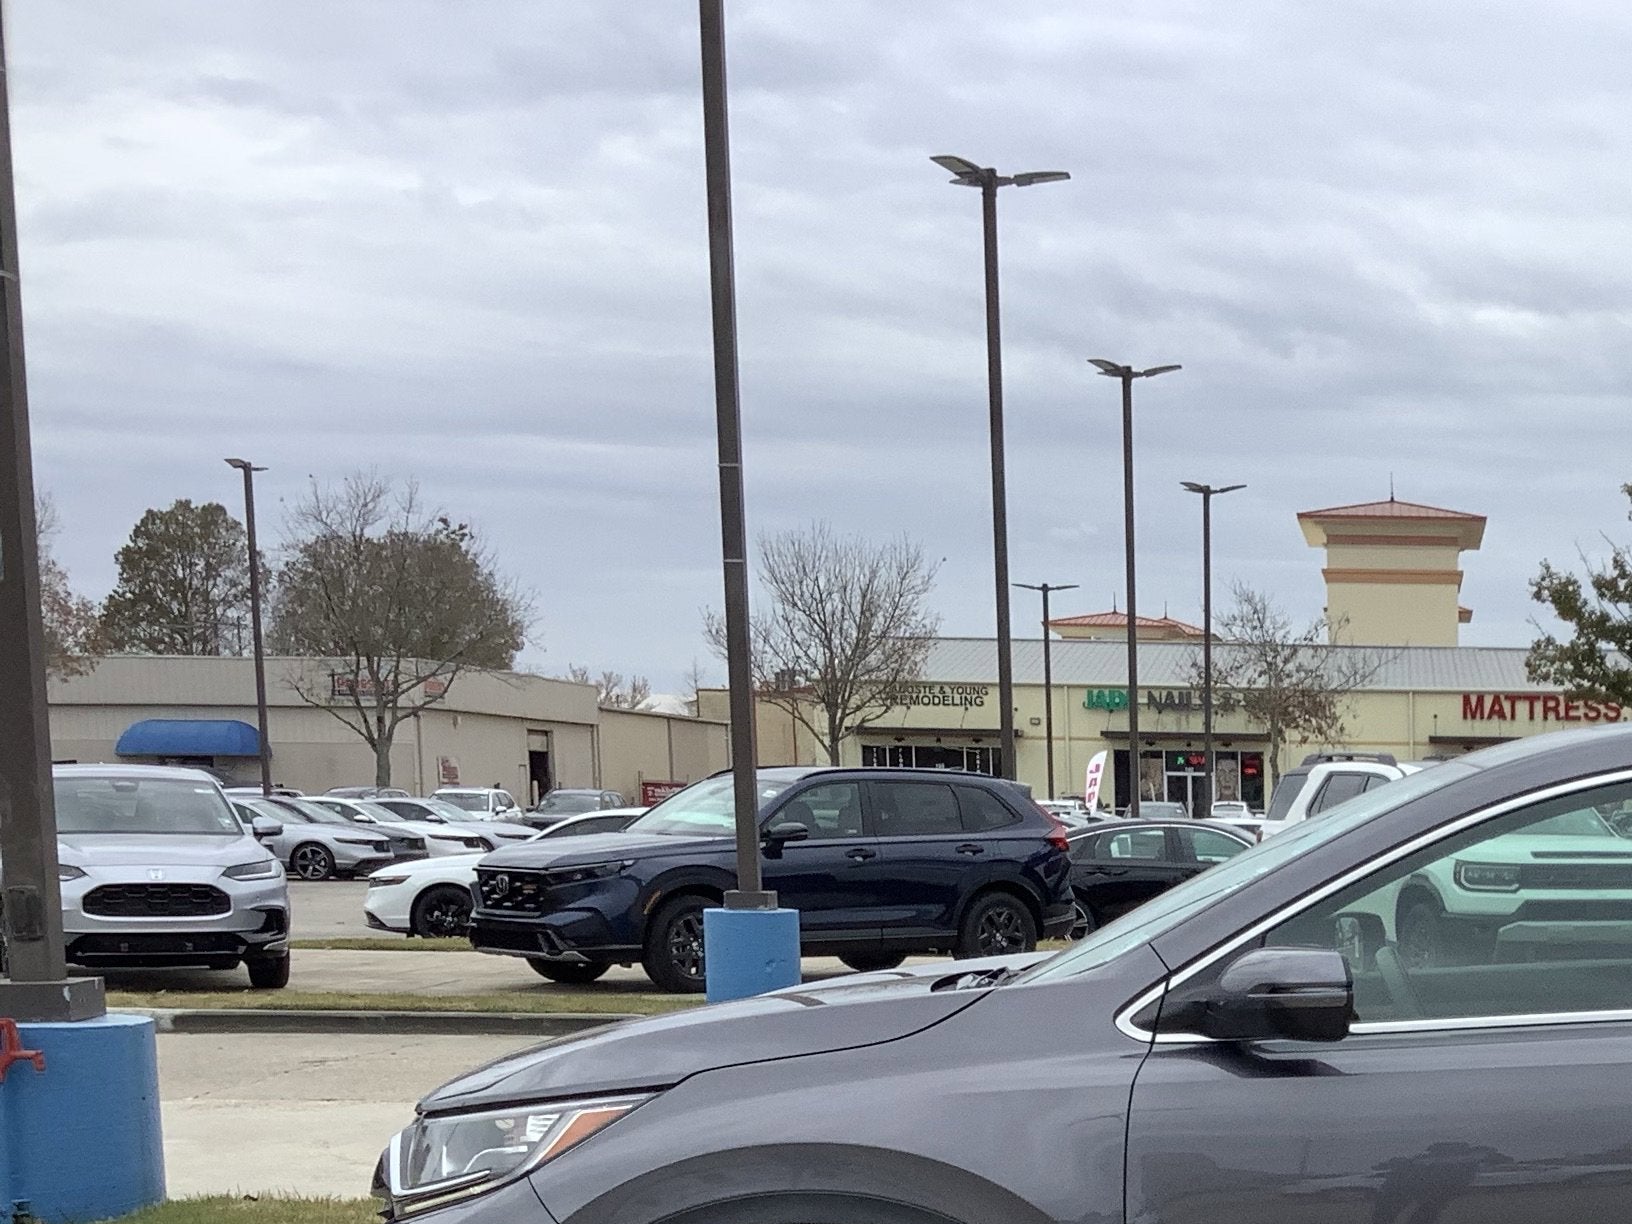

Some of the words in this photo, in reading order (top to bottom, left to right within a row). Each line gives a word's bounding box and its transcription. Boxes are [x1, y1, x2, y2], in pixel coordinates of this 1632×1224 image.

[939, 686, 946, 695] &
[949, 686, 989, 696] YOUNG
[889, 695, 985, 707] REMODELING
[1083, 689, 1131, 711] JAD
[1461, 694, 1622, 721] MATTRESS
